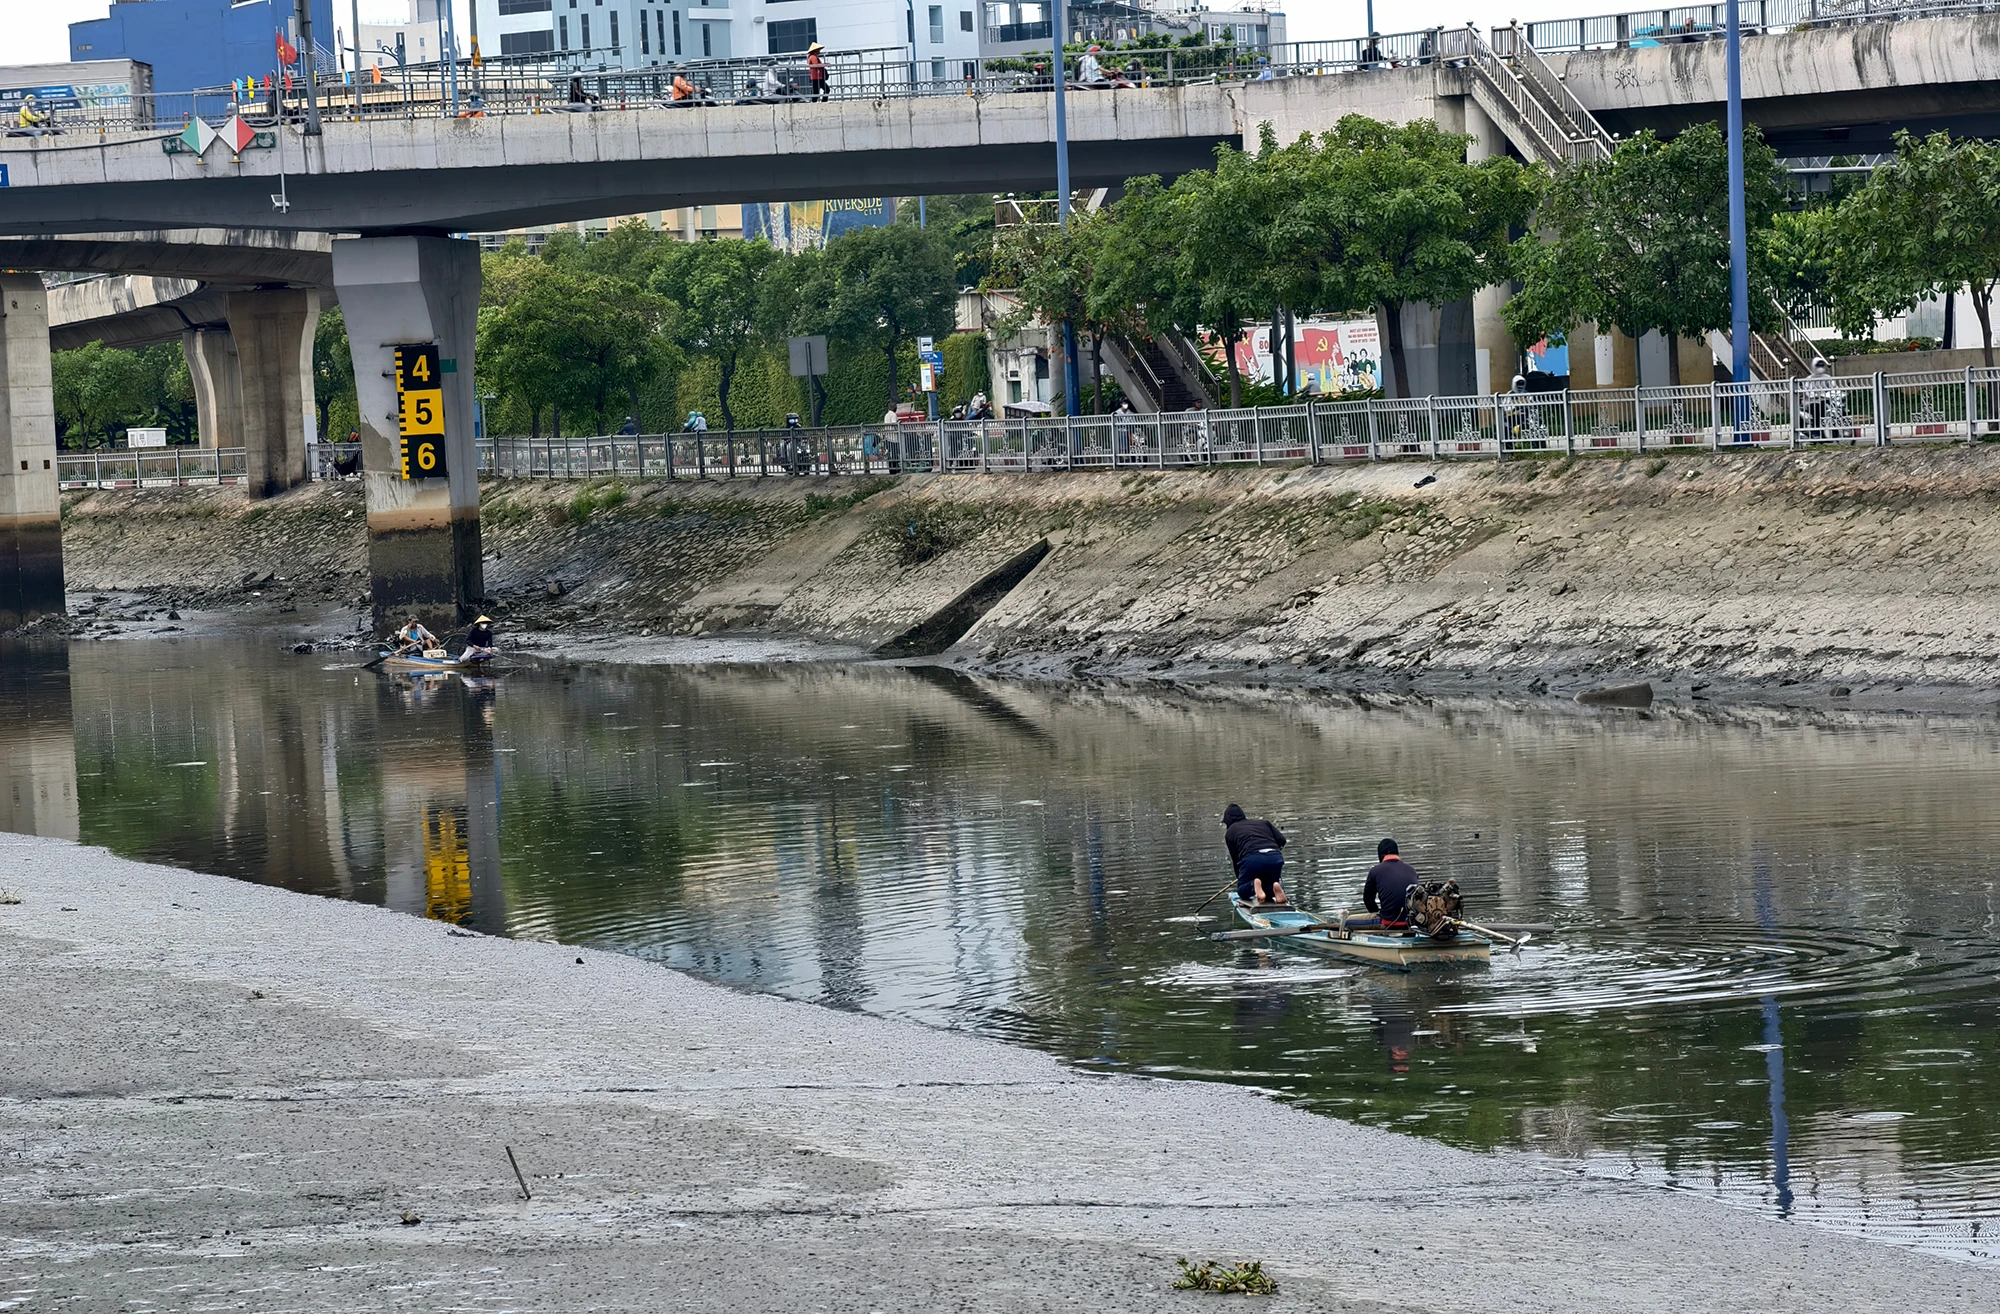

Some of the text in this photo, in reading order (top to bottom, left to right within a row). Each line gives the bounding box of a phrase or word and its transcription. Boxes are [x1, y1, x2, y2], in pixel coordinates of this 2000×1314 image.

[825, 197, 882, 212] RIVERSIDE
[863, 207, 882, 216] CITY
[1258, 340, 1269, 350] 80
[412, 355, 431, 382] 4
[415, 398, 433, 425] 5
[417, 442, 436, 470] 6
